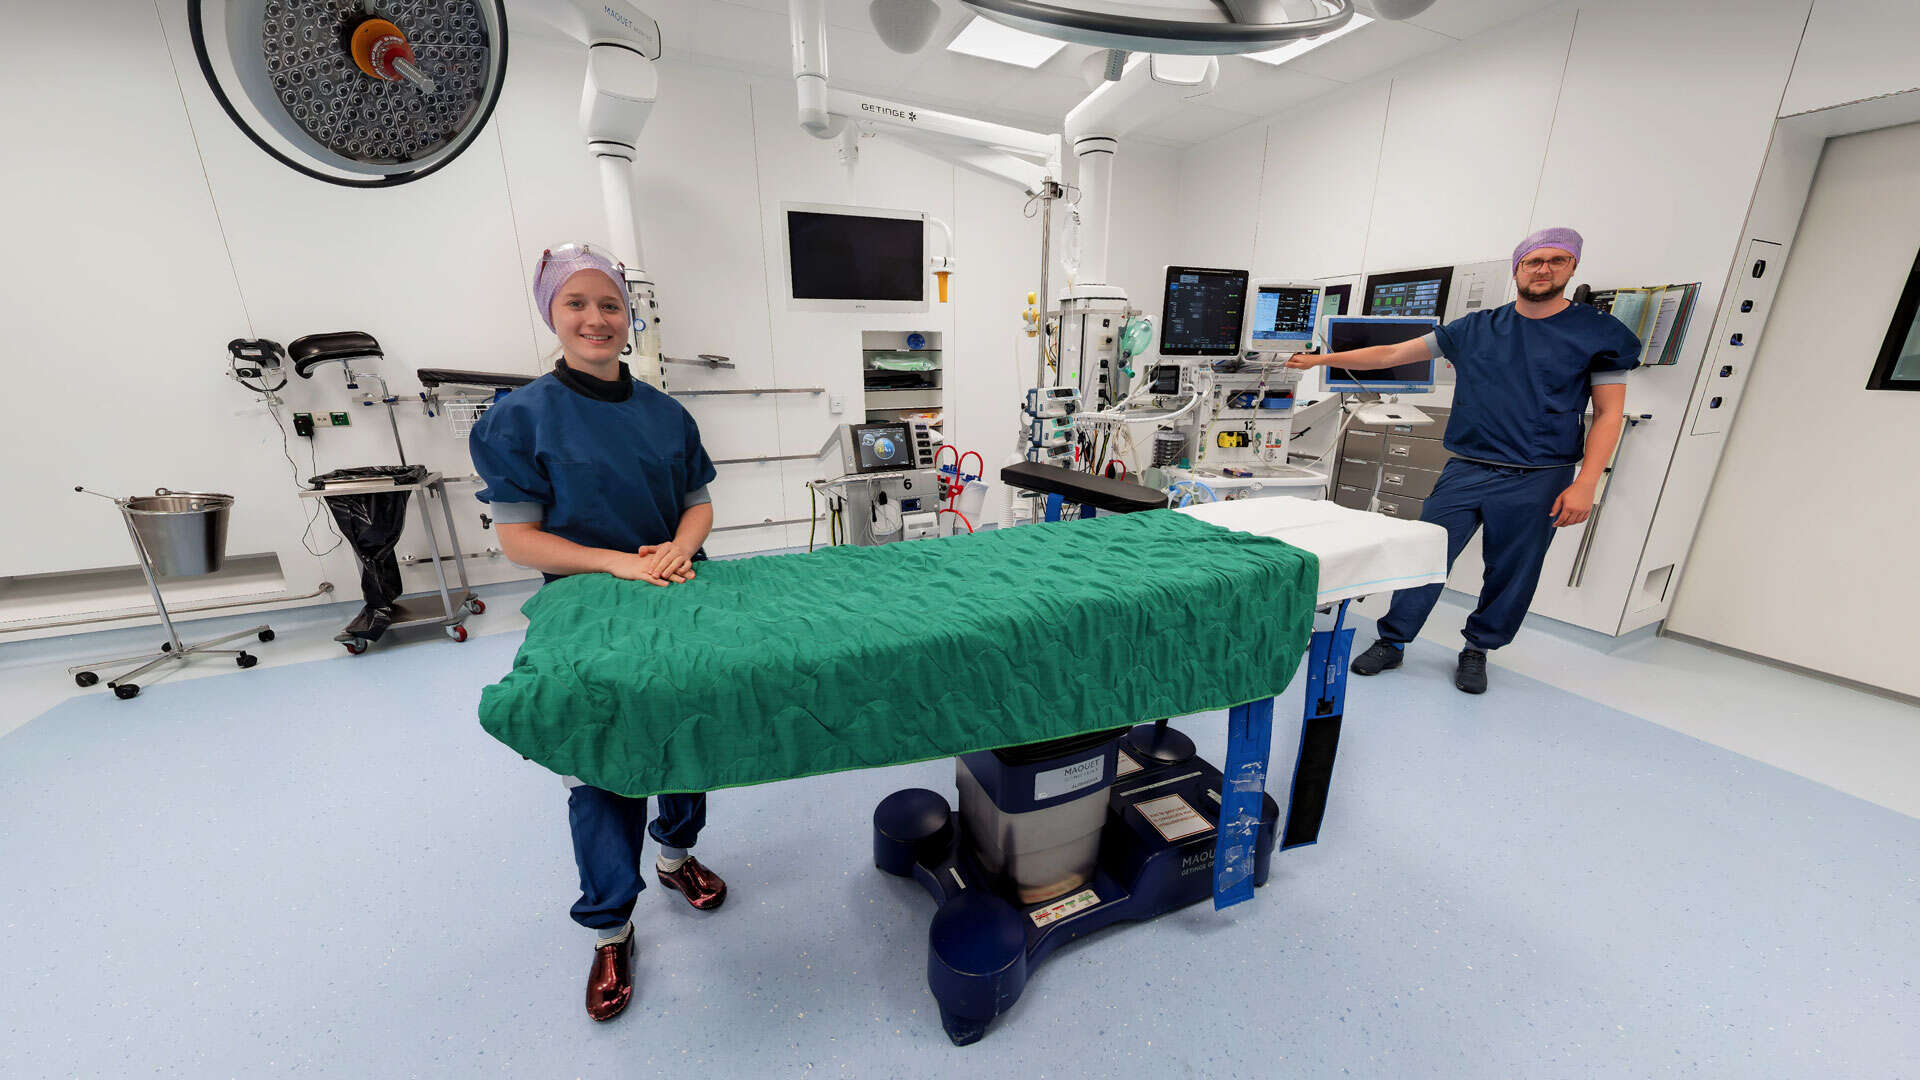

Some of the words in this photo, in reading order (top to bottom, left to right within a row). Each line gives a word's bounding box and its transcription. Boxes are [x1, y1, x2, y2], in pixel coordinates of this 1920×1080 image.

[604, 5, 632, 28] MAQUET
[861, 103, 906, 119] GETINGE
[903, 478, 913, 490] 6
[1064, 760, 1099, 776] MAQUET
[1182, 848, 1216, 868] MAQU
